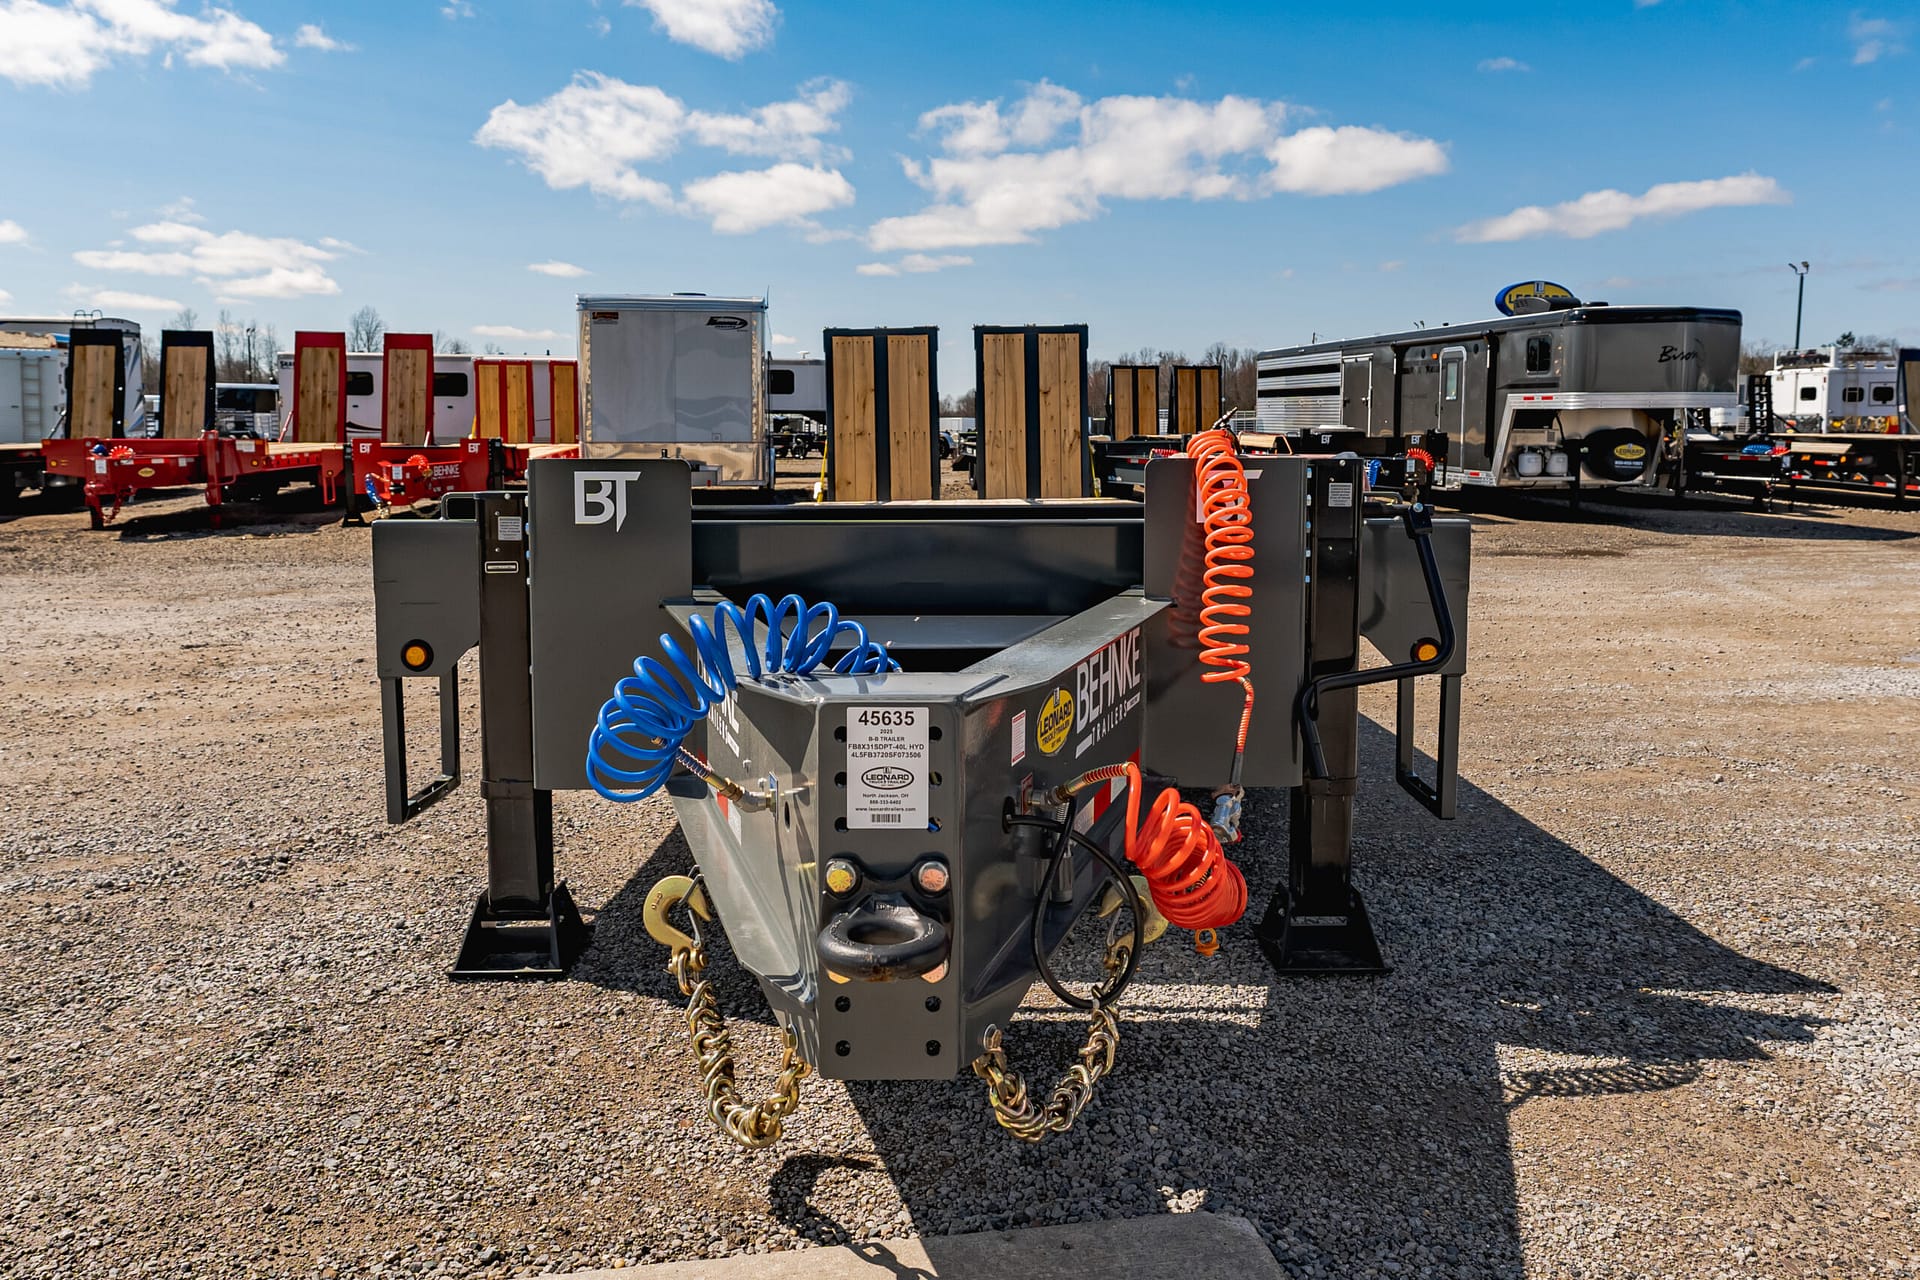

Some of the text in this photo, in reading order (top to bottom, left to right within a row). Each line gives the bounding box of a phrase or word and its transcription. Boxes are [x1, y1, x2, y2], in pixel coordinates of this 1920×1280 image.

[1657, 344, 1698, 363] Bison
[359, 443, 372, 454] BT
[468, 443, 481, 454] BT
[433, 464, 460, 477] BEHNKE
[573, 470, 642, 533] BT
[1076, 626, 1141, 734] BEHNKE
[858, 710, 915, 726] 45635
[1039, 700, 1072, 737] LEONARD
[1091, 699, 1128, 746] TRAILERS
